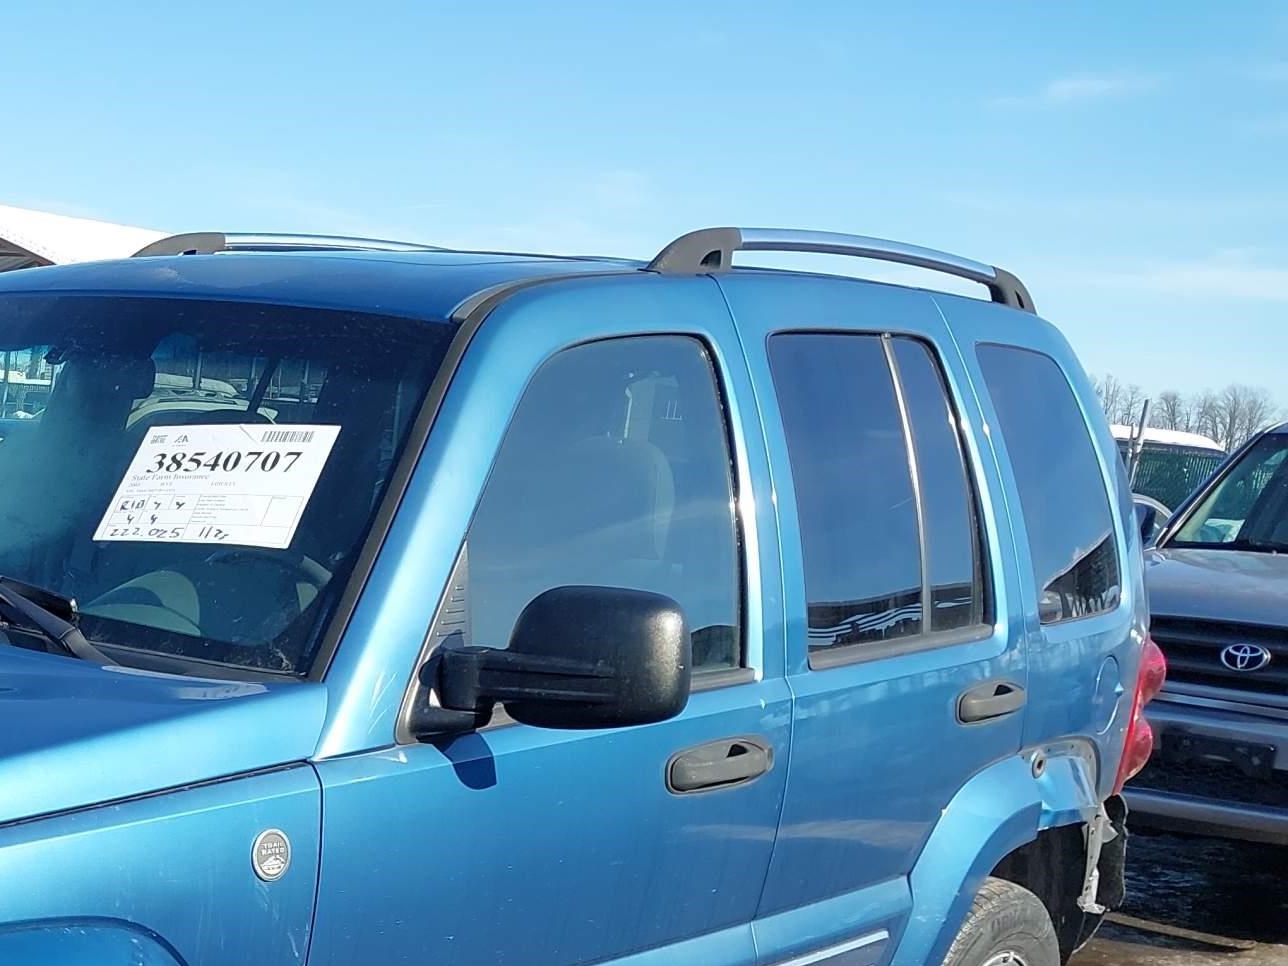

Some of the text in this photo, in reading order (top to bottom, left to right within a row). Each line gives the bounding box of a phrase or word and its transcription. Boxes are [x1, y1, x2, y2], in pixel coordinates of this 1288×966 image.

[146, 451, 303, 473] 38540707
[261, 842, 283, 850] TRAIL
[261, 847, 285, 856] RATED
